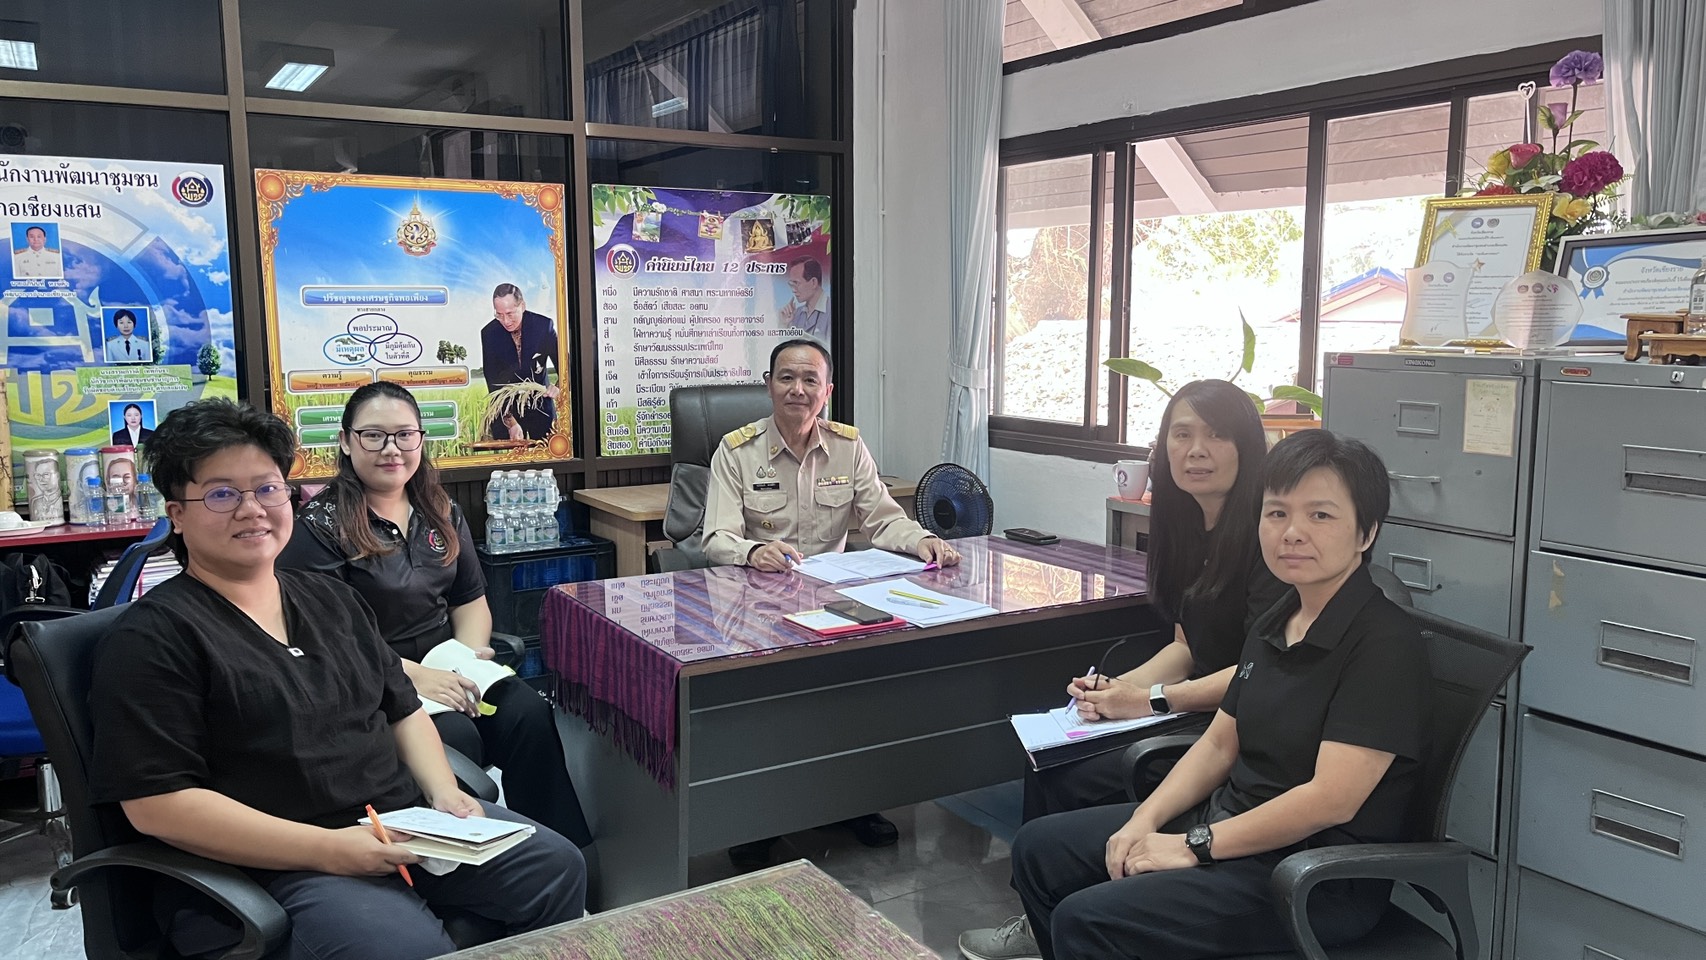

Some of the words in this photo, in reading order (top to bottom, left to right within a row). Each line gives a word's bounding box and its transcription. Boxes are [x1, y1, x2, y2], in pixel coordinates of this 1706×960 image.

[645, 257, 715, 272] ค่านิยมไทย
[722, 263, 738, 272] 12
[746, 261, 787, 273] ประการ
[602, 285, 617, 297] หนึ่ง
[633, 286, 678, 297] มีความรักชาติ
[681, 289, 703, 297] ศาสนา
[602, 303, 618, 311] สอง
[661, 302, 686, 311] เสียสละ
[690, 303, 709, 311] อดทน
[603, 316, 617, 325] สาม
[689, 315, 721, 328] ผู้ปกครอง
[767, 326, 803, 338] และทางอ้อม
[335, 345, 365, 354] มีเหตุผล
[604, 359, 615, 367] หก
[605, 371, 618, 381] เจ็ด
[606, 386, 621, 395] แปด
[636, 384, 665, 395] มีระเบียบ
[606, 399, 618, 409] เก้า
[606, 413, 617, 423] สิบ
[606, 427, 630, 437] สิบเอ็ด
[607, 441, 632, 450] สิบสอง
